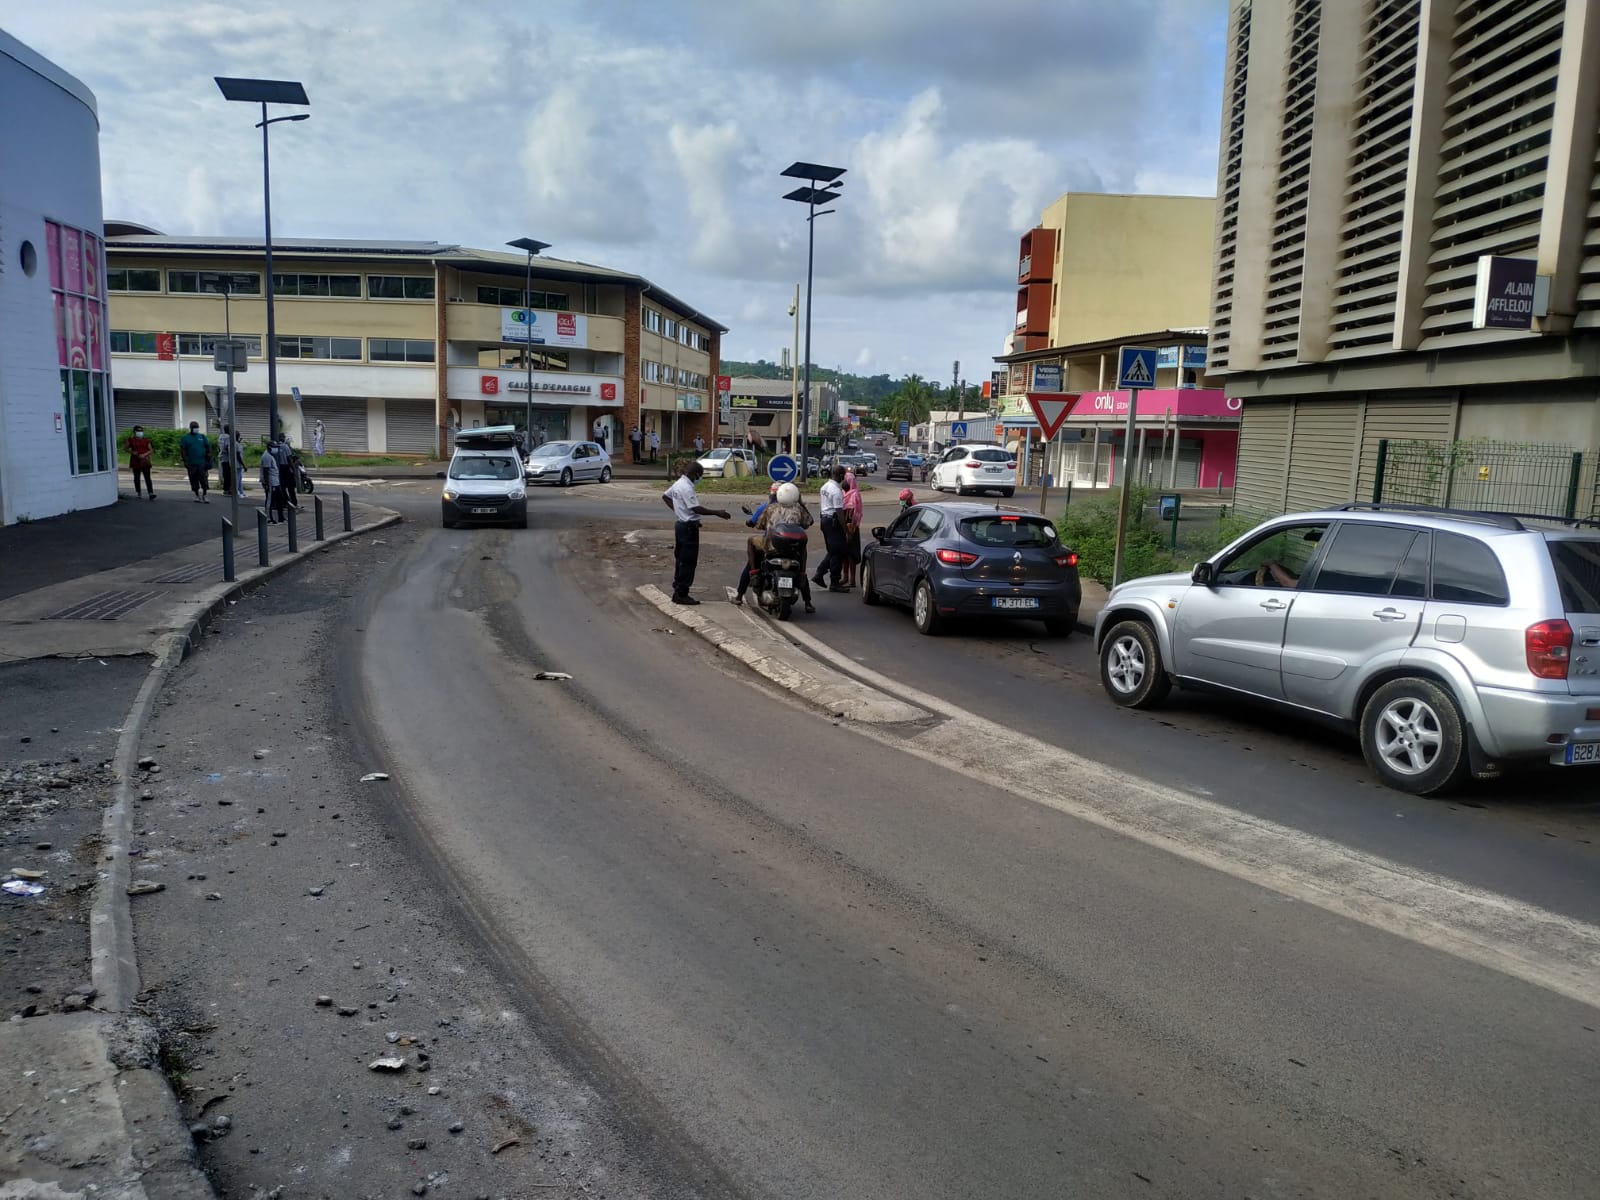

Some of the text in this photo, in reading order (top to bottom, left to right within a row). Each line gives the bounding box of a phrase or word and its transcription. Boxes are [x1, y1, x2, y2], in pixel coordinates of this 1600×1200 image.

[1504, 282, 1533, 296] ALAIN
[1488, 298, 1532, 313] AFFLELOU
[1094, 392, 1114, 414] only
[1574, 744, 1594, 761] 628
